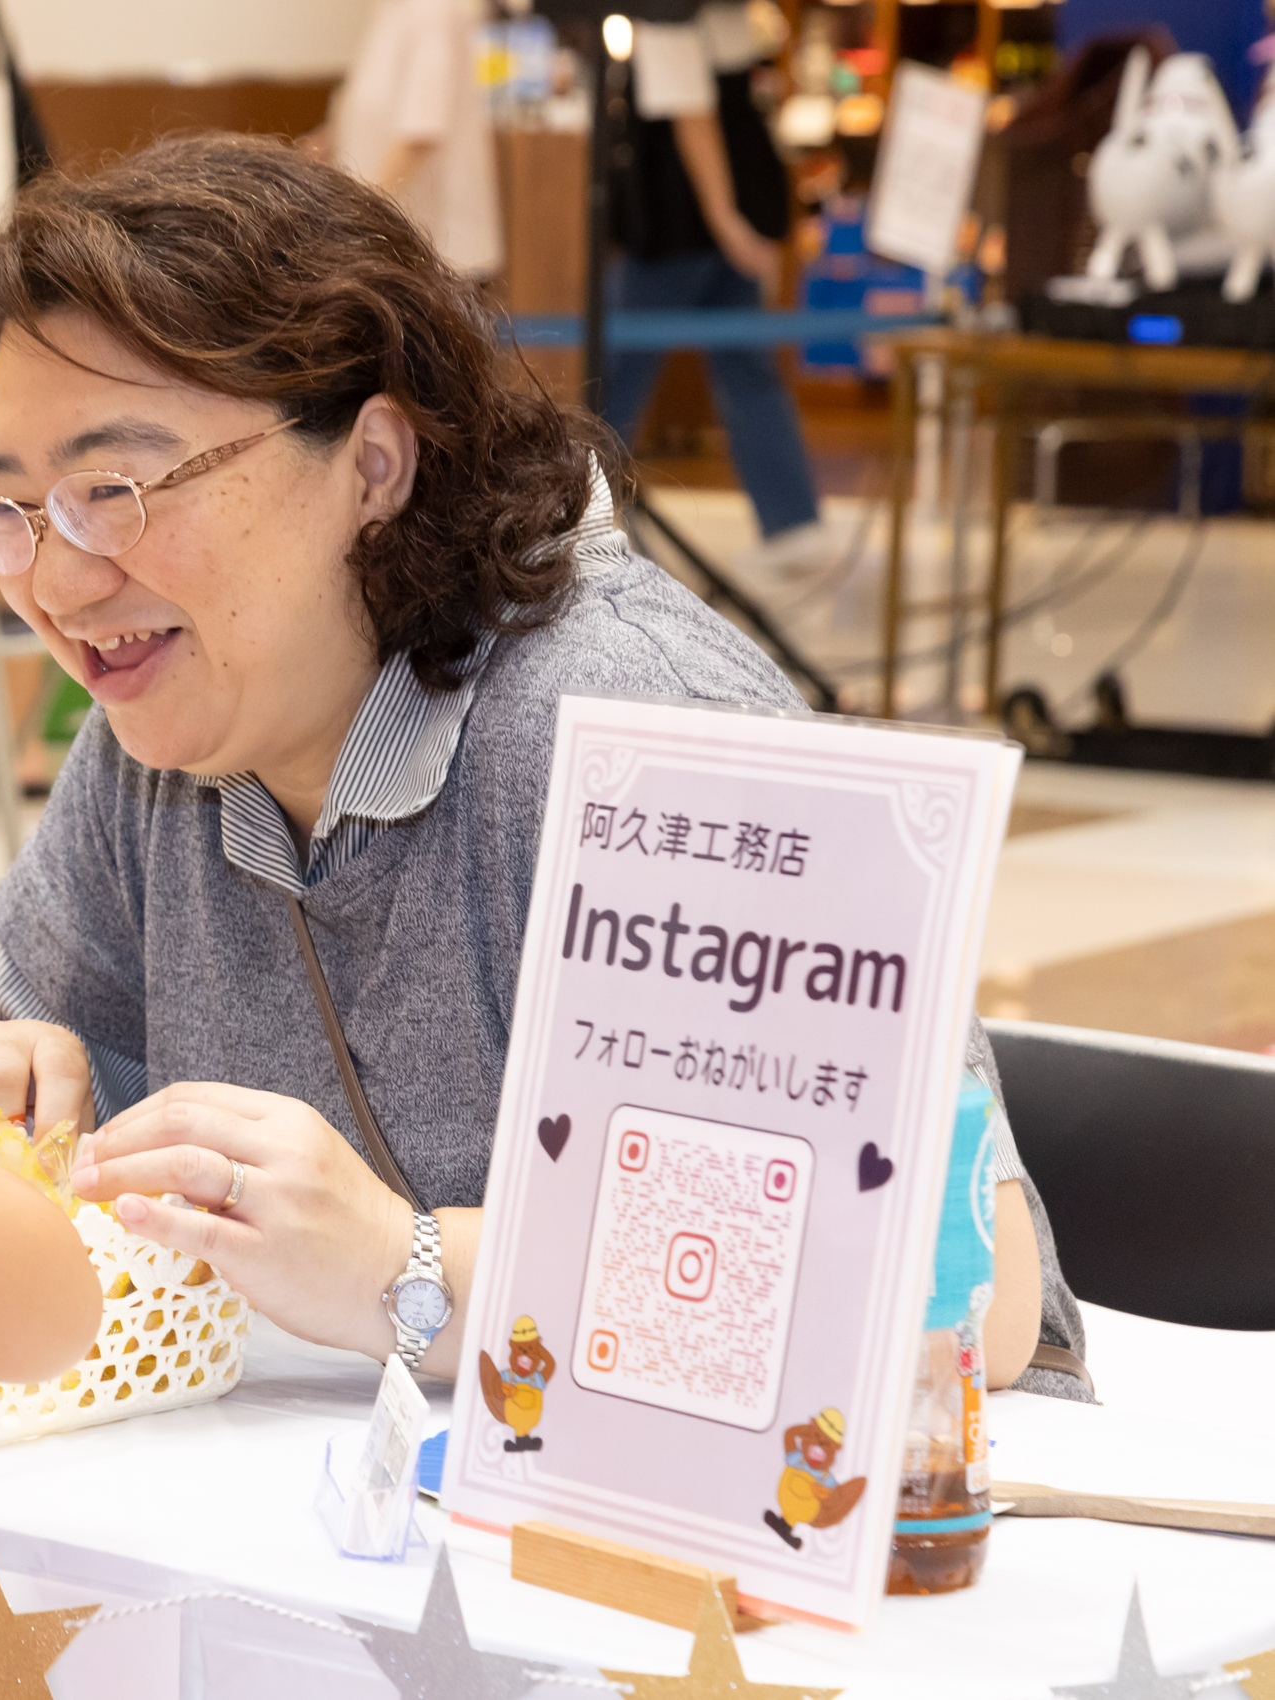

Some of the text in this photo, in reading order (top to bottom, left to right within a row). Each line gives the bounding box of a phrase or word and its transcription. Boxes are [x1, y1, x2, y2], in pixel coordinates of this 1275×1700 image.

[580, 802, 811, 877] 阿久津工務店
[562, 883, 907, 1013] Instagram
[575, 1019, 869, 1114] フォローおねがいします
